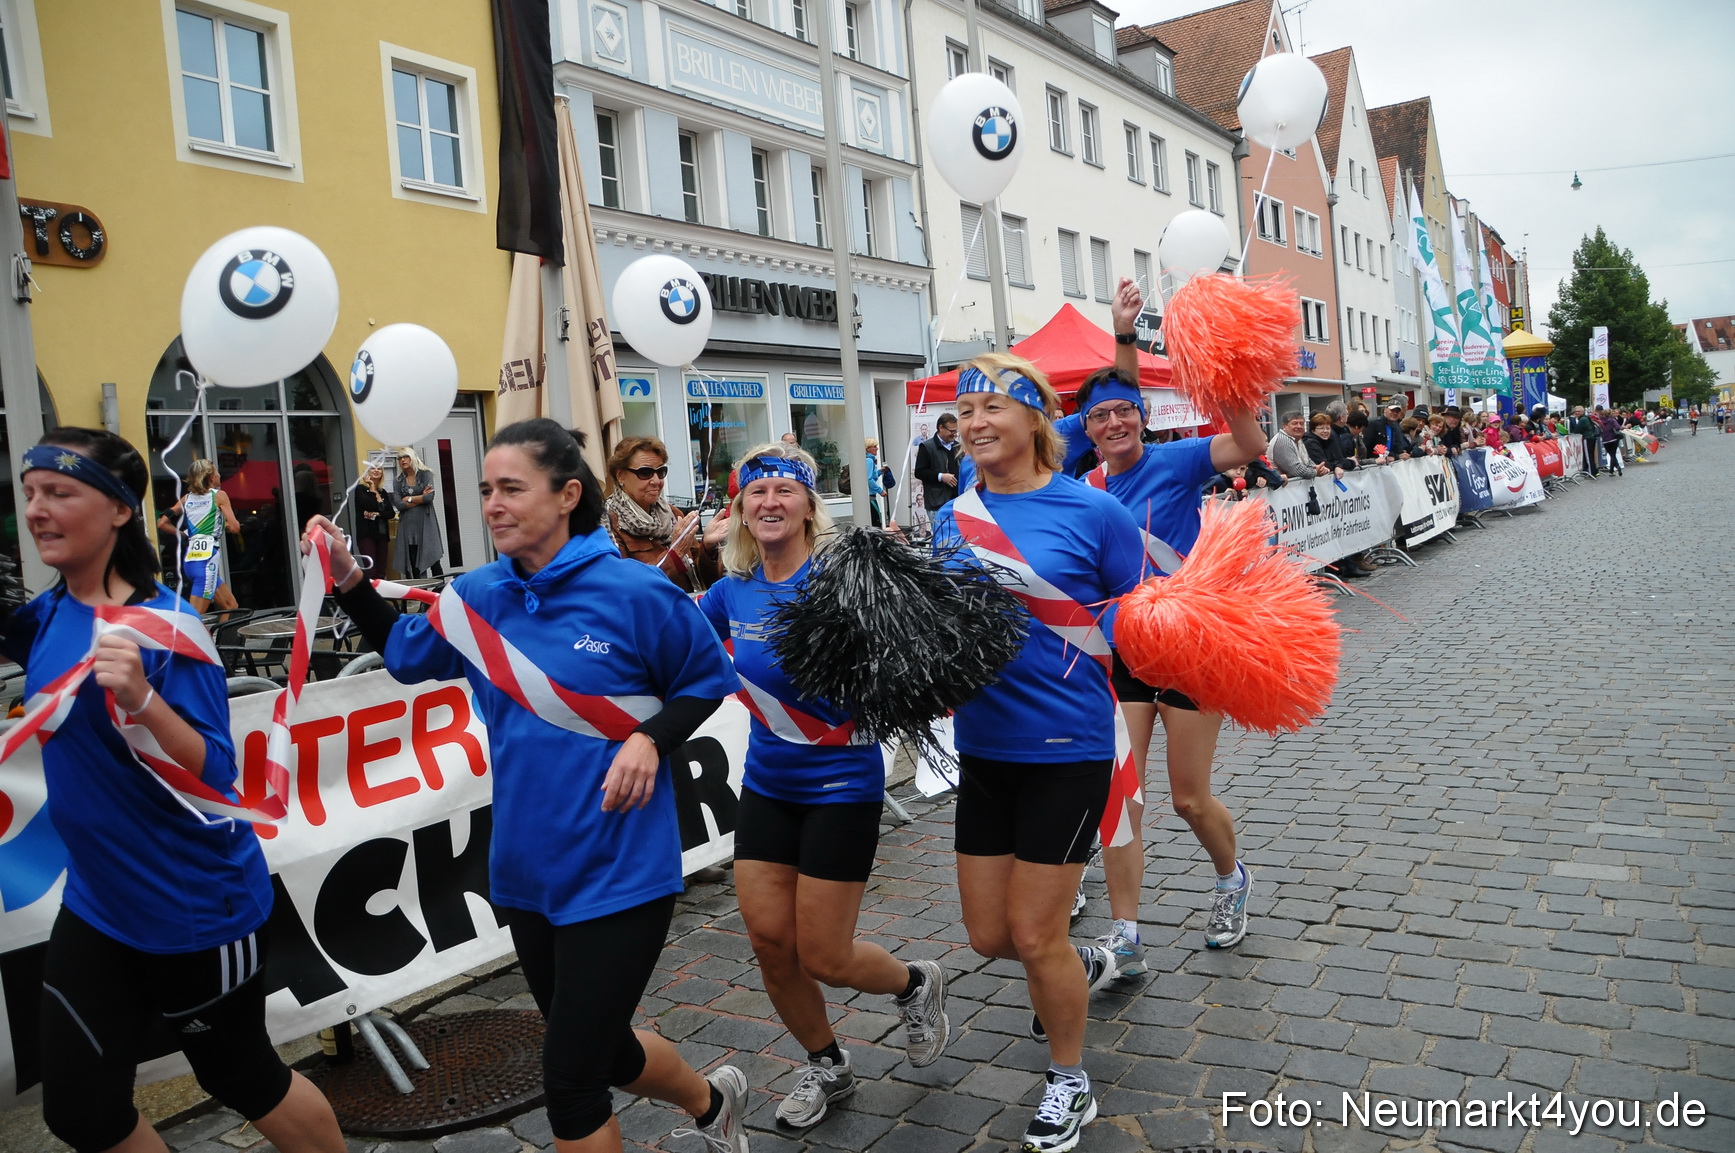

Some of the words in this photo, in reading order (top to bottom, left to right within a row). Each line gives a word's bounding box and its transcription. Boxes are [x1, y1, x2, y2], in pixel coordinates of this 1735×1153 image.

[676, 42, 758, 96] BRILLEN
[759, 71, 824, 116] WEBER
[974, 107, 1015, 128] BMW
[237, 249, 294, 289] BMW
[660, 278, 695, 299] BMW
[697, 271, 779, 316] RILLEN
[1482, 376, 1503, 386] 6352
[1594, 366, 1605, 379] B
[692, 382, 729, 396] BRILLEN
[729, 382, 761, 397] WEBER
[793, 385, 825, 399] BRILLEN
[824, 387, 845, 400] WEBE
[1281, 502, 1305, 534] BMW
[583, 638, 611, 654] asics
